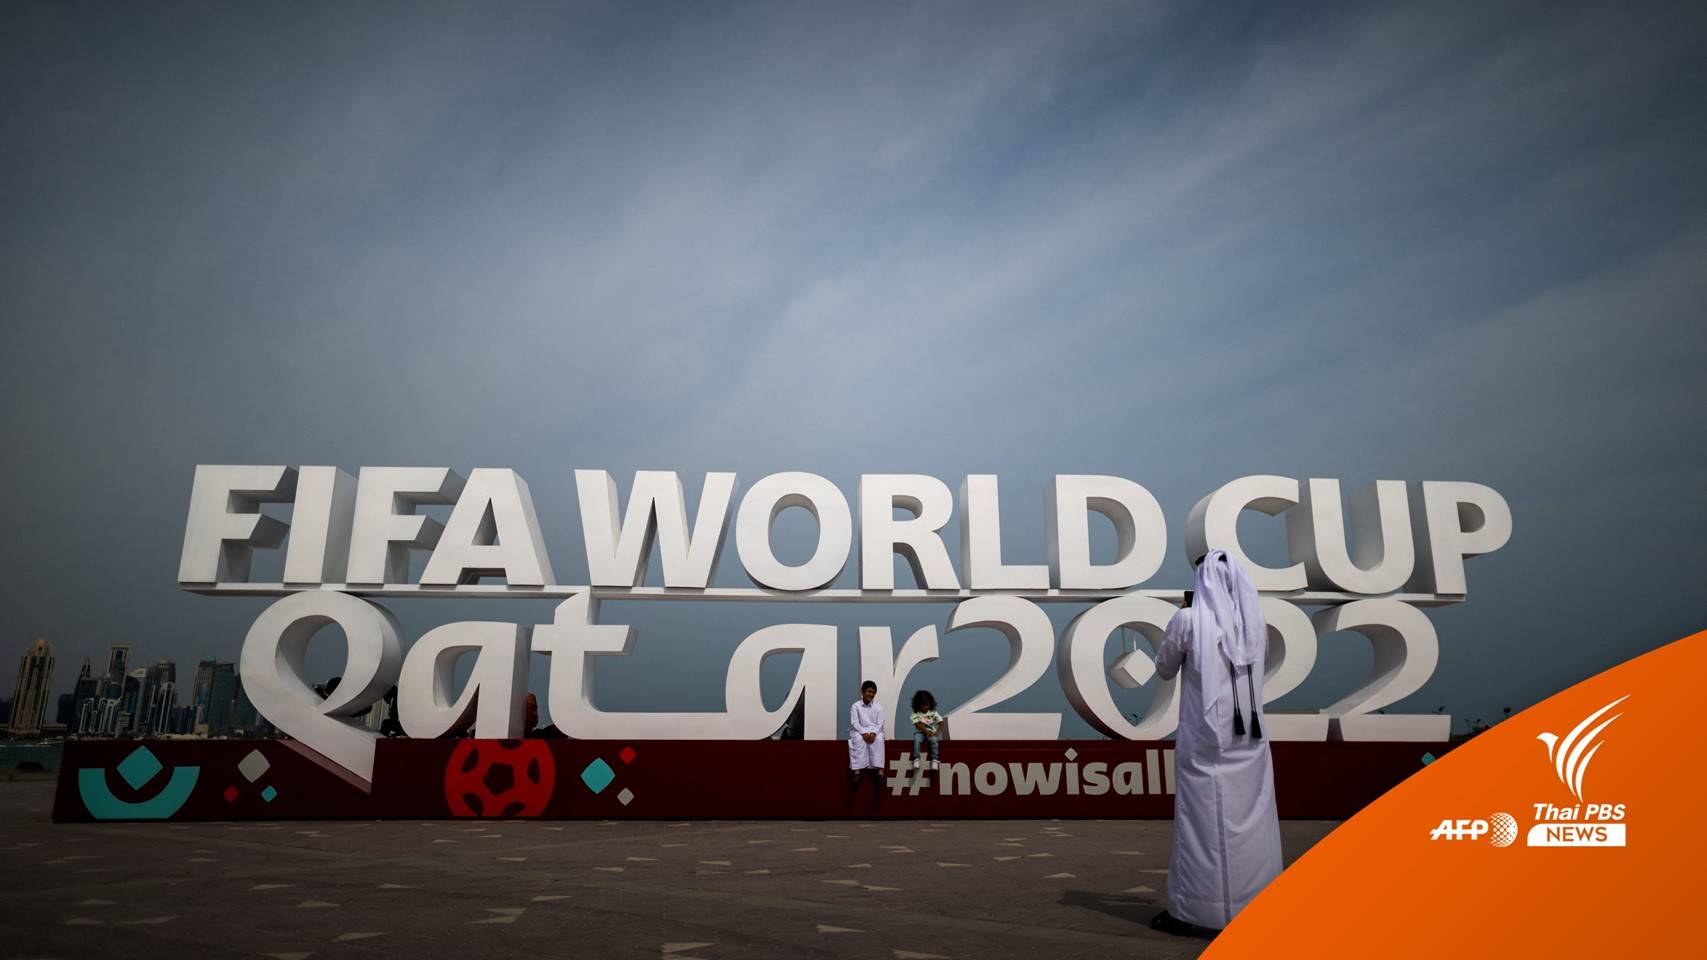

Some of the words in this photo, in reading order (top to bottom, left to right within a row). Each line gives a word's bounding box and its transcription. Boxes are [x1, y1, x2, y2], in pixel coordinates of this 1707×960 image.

[178, 464, 555, 587] FIFA
[574, 469, 1168, 591] WORLD
[1186, 474, 1513, 595] CUP
